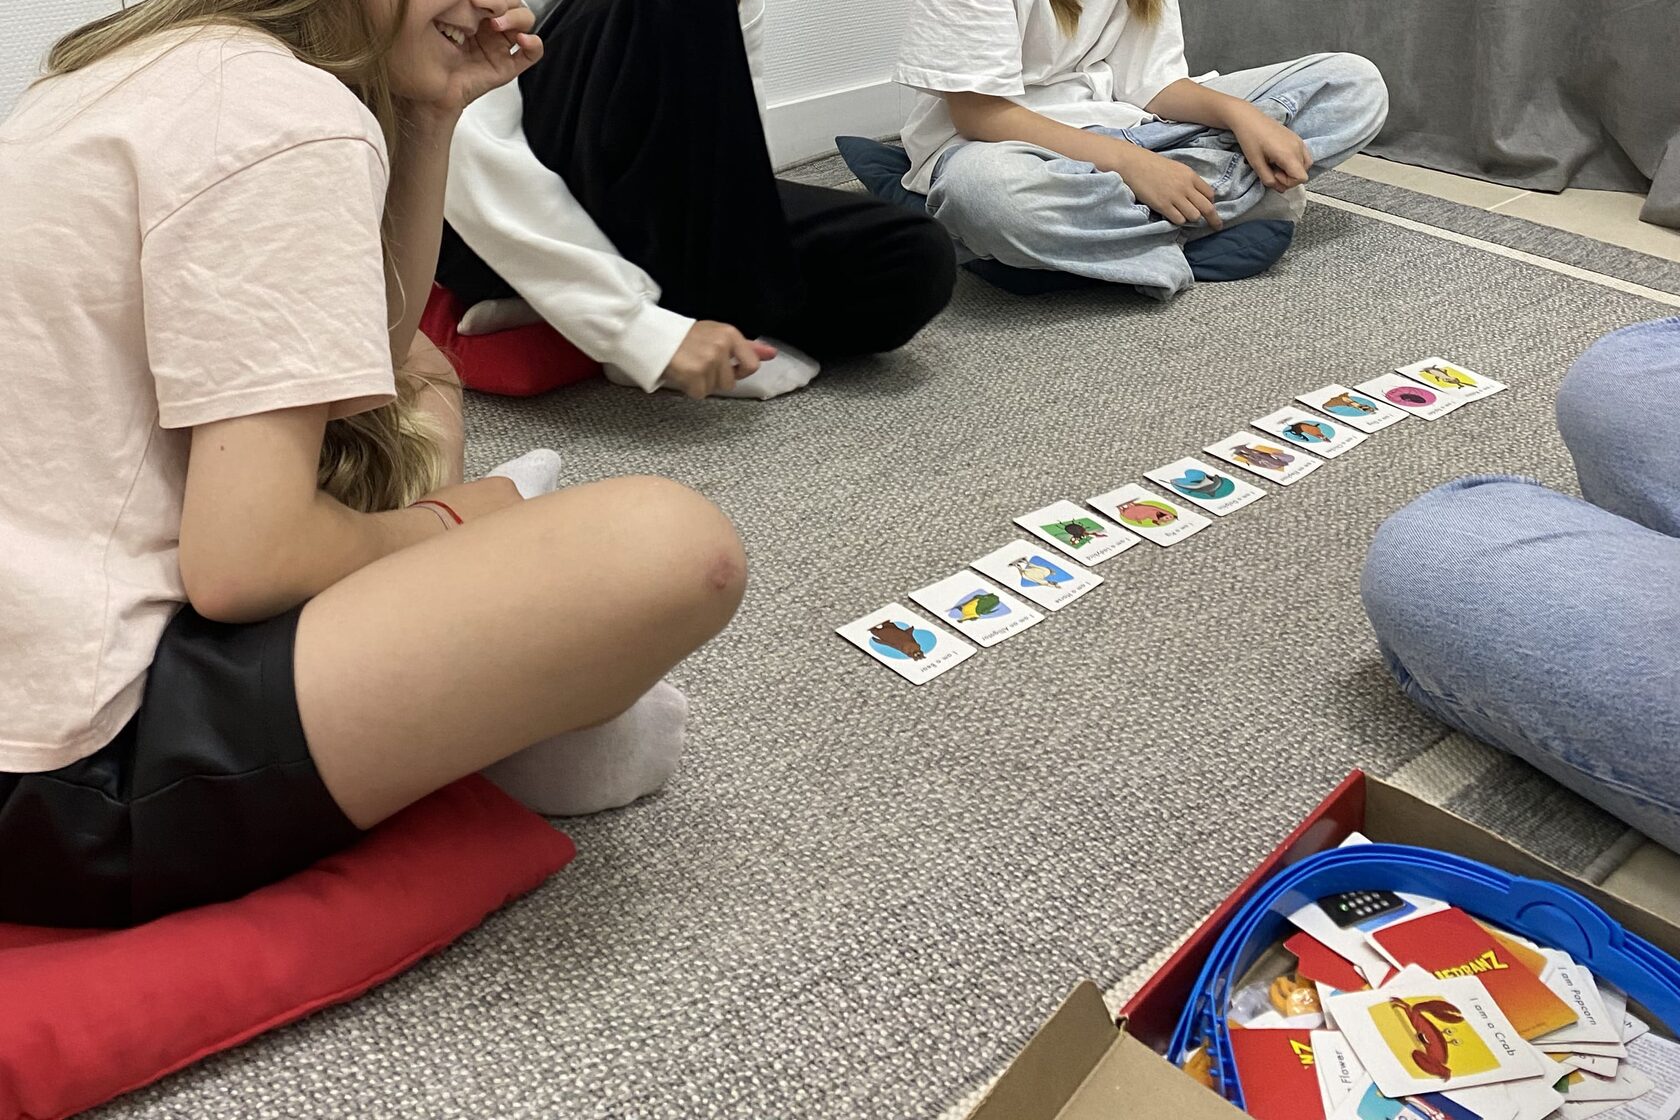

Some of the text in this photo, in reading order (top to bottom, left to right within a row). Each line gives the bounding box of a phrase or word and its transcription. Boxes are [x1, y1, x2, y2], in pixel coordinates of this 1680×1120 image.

[1561, 973, 1574, 987] am
[1571, 989, 1597, 1026] Popcorn
[1474, 1004, 1488, 1019] am
[1495, 1032, 1516, 1056] Crab
[1335, 1049, 1352, 1084] Flower
